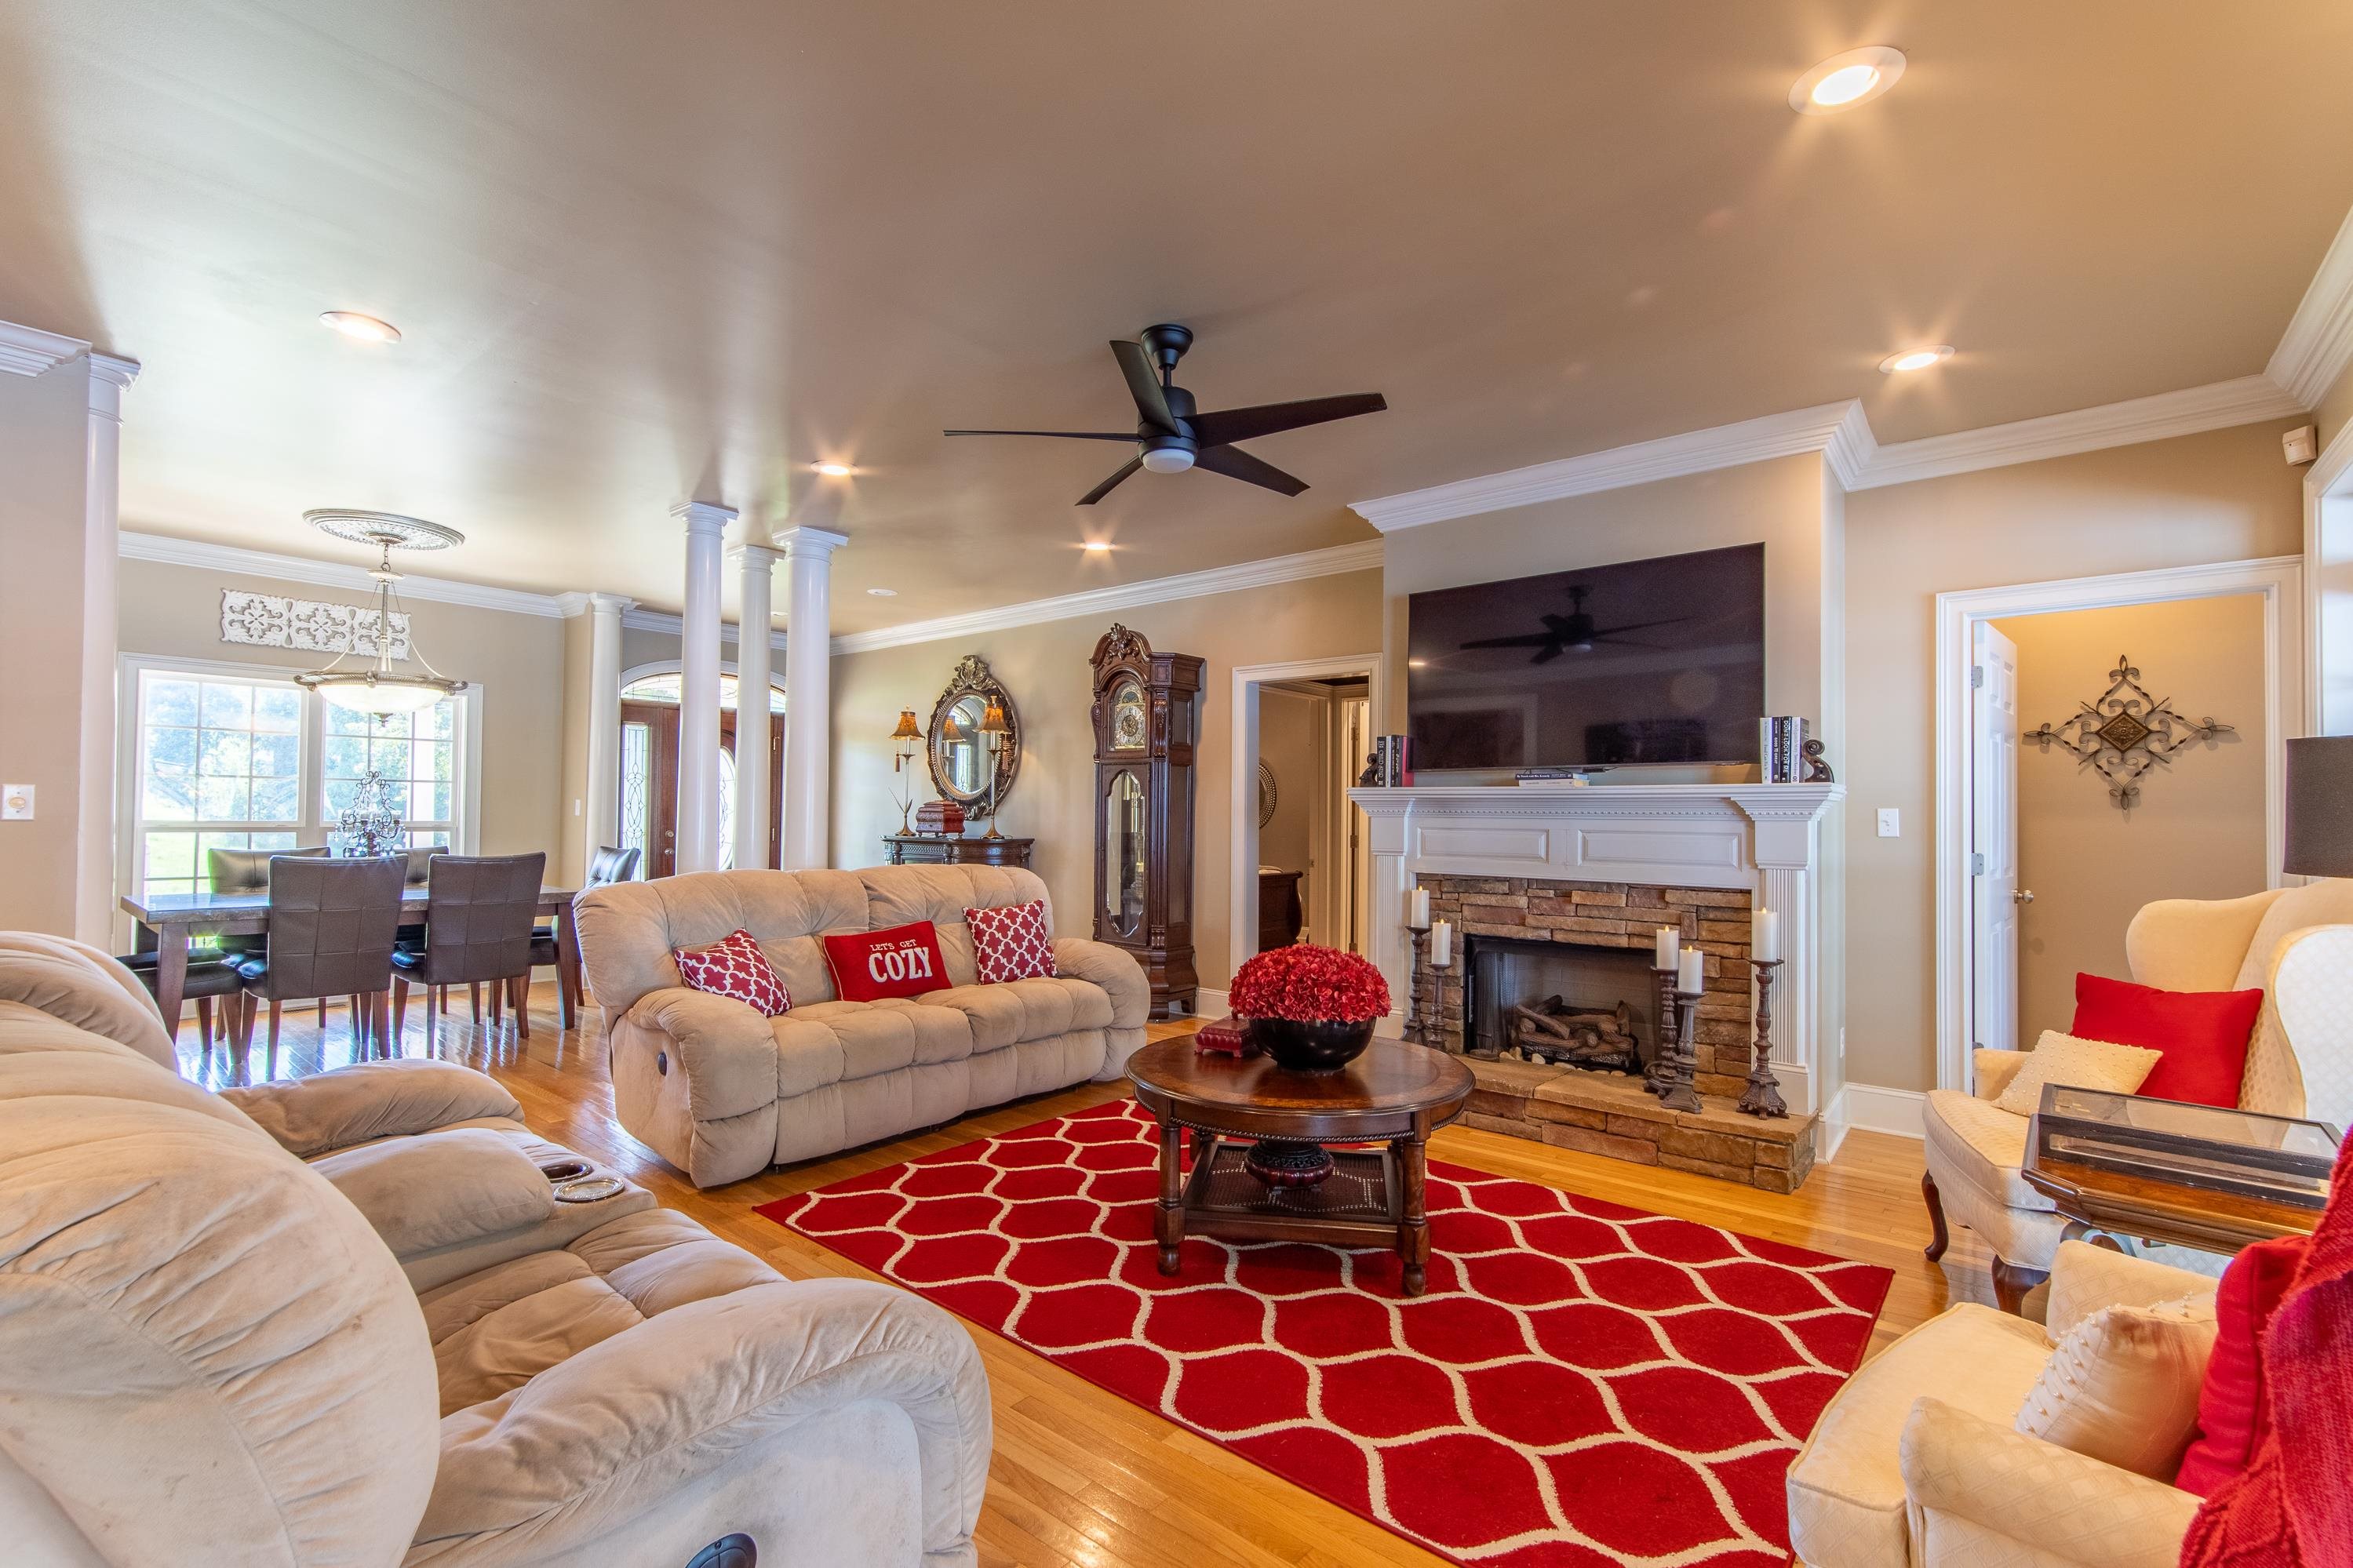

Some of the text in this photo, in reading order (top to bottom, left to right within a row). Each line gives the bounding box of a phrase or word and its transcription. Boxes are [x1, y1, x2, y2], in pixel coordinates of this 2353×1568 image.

[869, 939, 917, 951] LET'S GET
[869, 947, 933, 983] COZY
